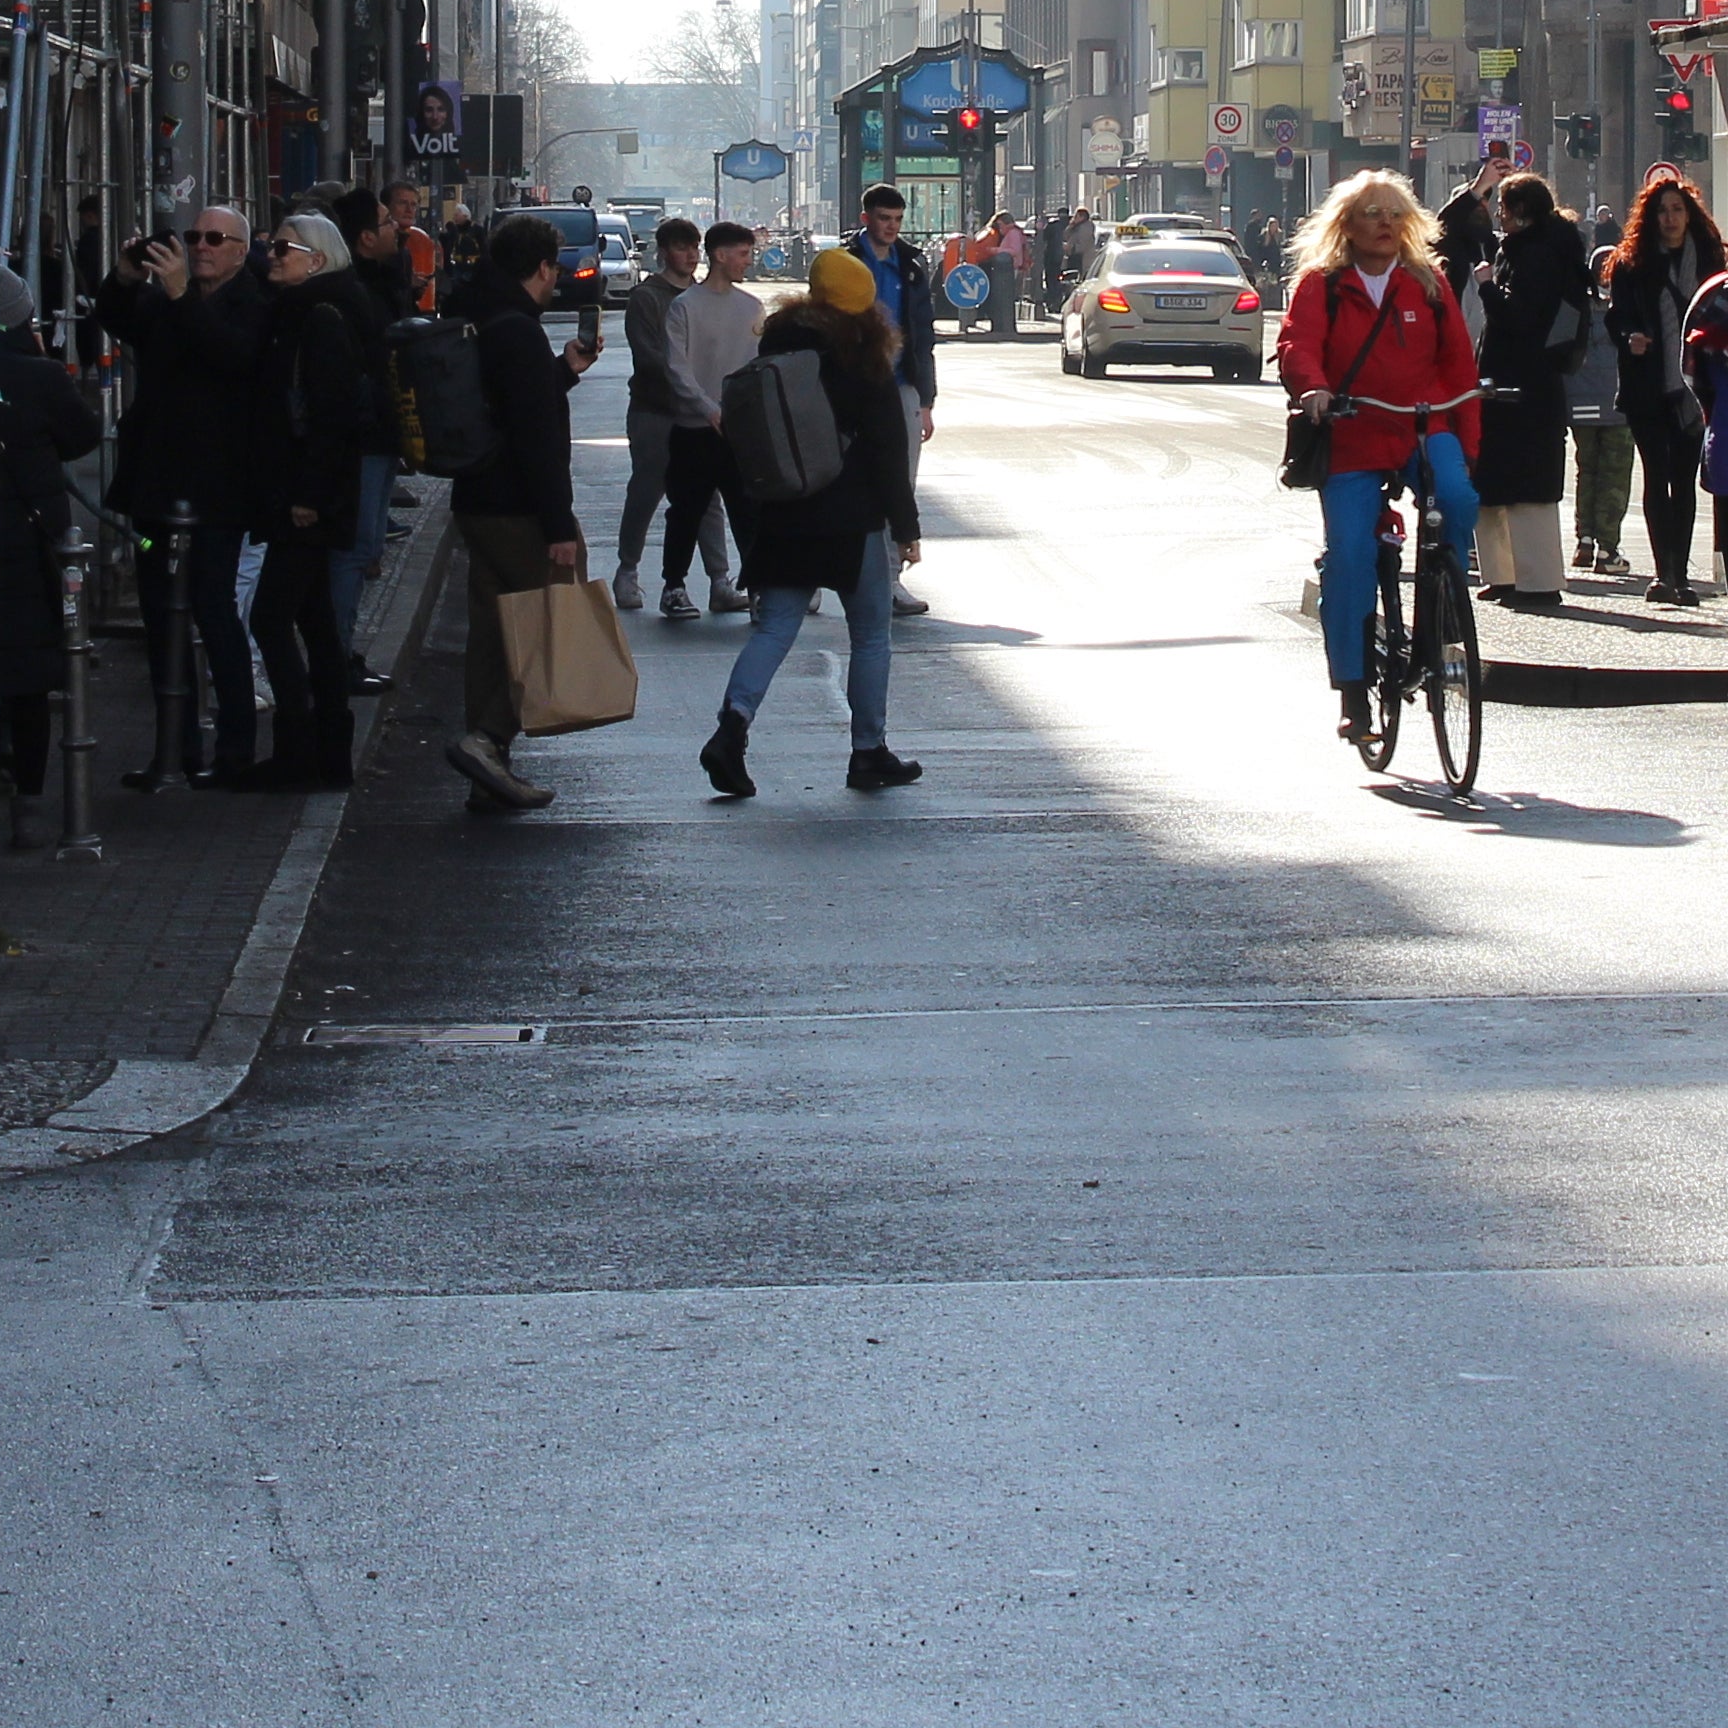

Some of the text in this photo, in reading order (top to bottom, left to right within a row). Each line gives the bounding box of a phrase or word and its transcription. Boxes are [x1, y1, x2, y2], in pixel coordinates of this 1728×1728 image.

[1425, 104, 1449, 113] ATM
[1220, 113, 1236, 127] 30
[410, 132, 460, 154] Volt
[1217, 135, 1238, 143] ZONE
[747, 149, 761, 165] U
